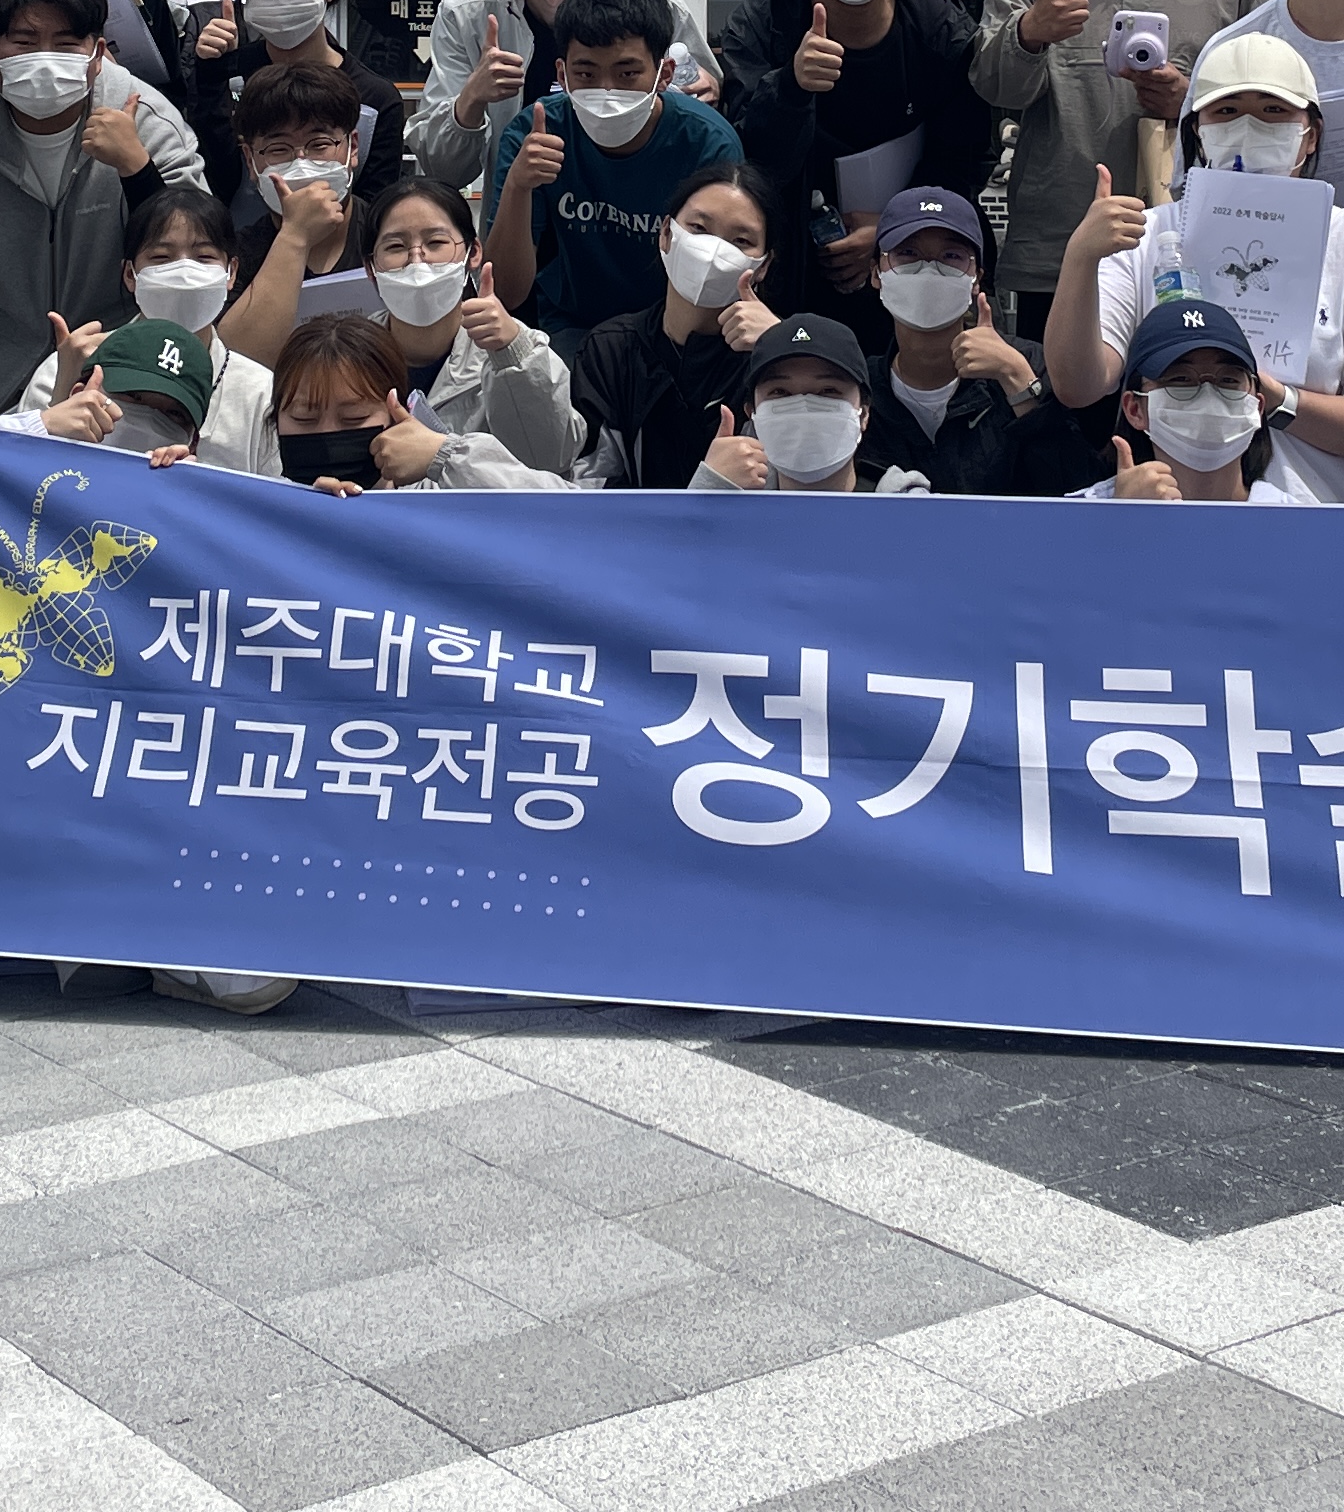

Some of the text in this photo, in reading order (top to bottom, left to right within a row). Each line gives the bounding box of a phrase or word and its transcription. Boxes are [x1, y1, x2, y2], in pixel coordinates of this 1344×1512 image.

[408, 22, 433, 31] Ticke
[558, 192, 663, 233] COVERNA
[1212, 206, 1232, 216] 2022
[1182, 310, 1205, 328] NY
[158, 339, 184, 375] LA
[1263, 340, 1295, 367] 지수
[32, 471, 64, 515] EDUCATION
[24, 517, 41, 574] GEOGRAPHY
[139, 589, 604, 707] 제주대학교
[26, 701, 600, 831] 지리교육전공
